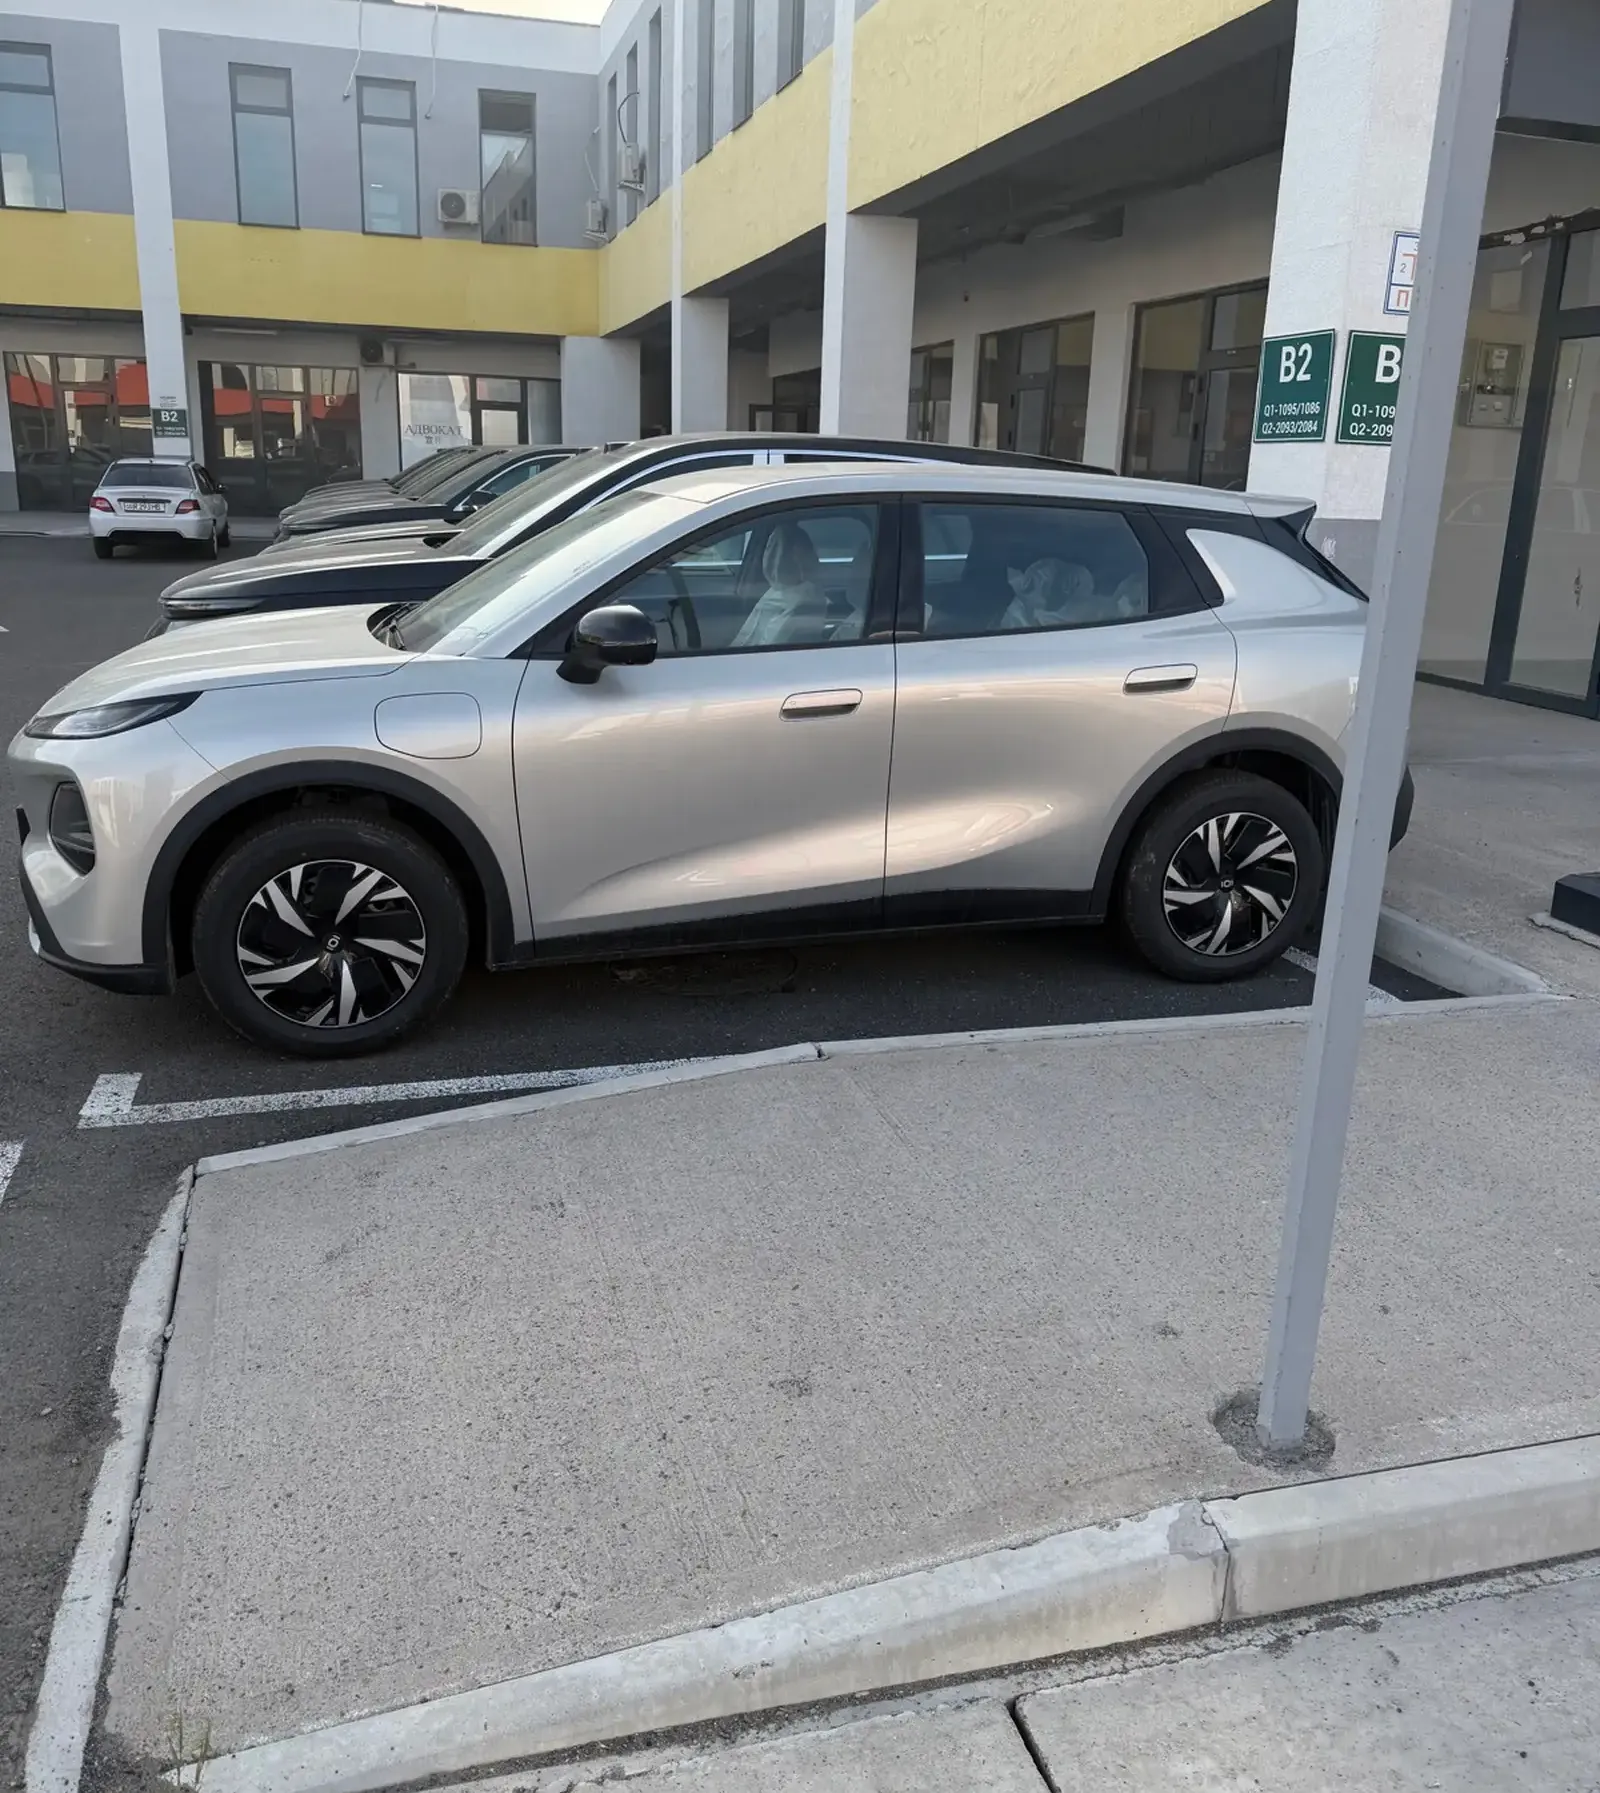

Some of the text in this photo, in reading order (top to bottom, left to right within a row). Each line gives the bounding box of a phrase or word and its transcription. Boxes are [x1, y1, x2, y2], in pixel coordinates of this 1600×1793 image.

[1399, 262, 1407, 273] 2
[1279, 342, 1313, 383] B2
[1375, 344, 1401, 383] B
[160, 410, 179, 422] B2
[1263, 401, 1321, 417] Q1-1095/1086
[404, 424, 463, 436] АДВОКАТ
[1261, 420, 1318, 434] Q2-2093/2084
